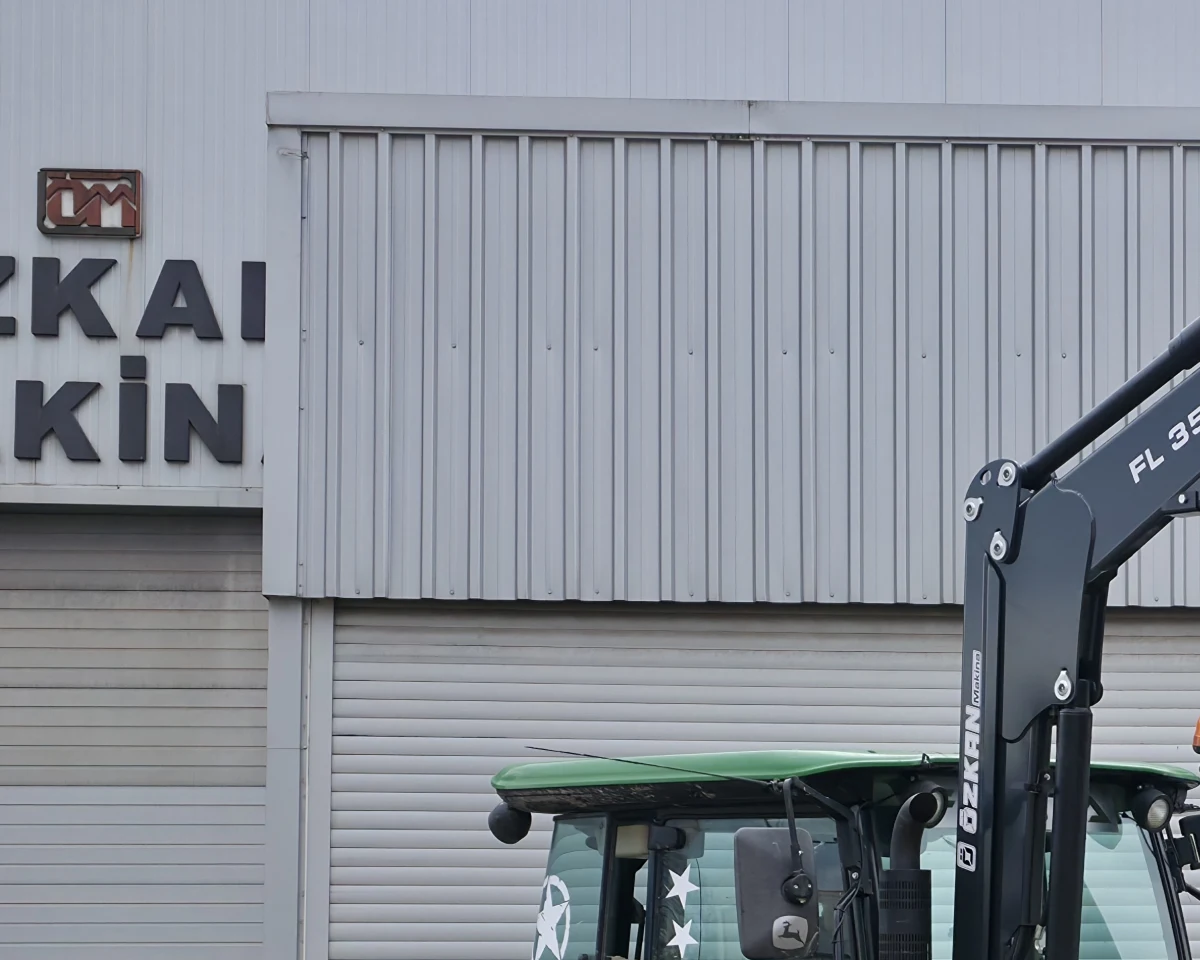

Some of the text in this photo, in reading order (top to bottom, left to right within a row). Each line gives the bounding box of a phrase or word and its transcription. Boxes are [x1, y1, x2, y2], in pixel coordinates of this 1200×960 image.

[0, 255, 267, 342] KA
[1128, 448, 1165, 484] FL
[959, 704, 982, 835] ÖZKAN
[972, 652, 982, 704] Makina
